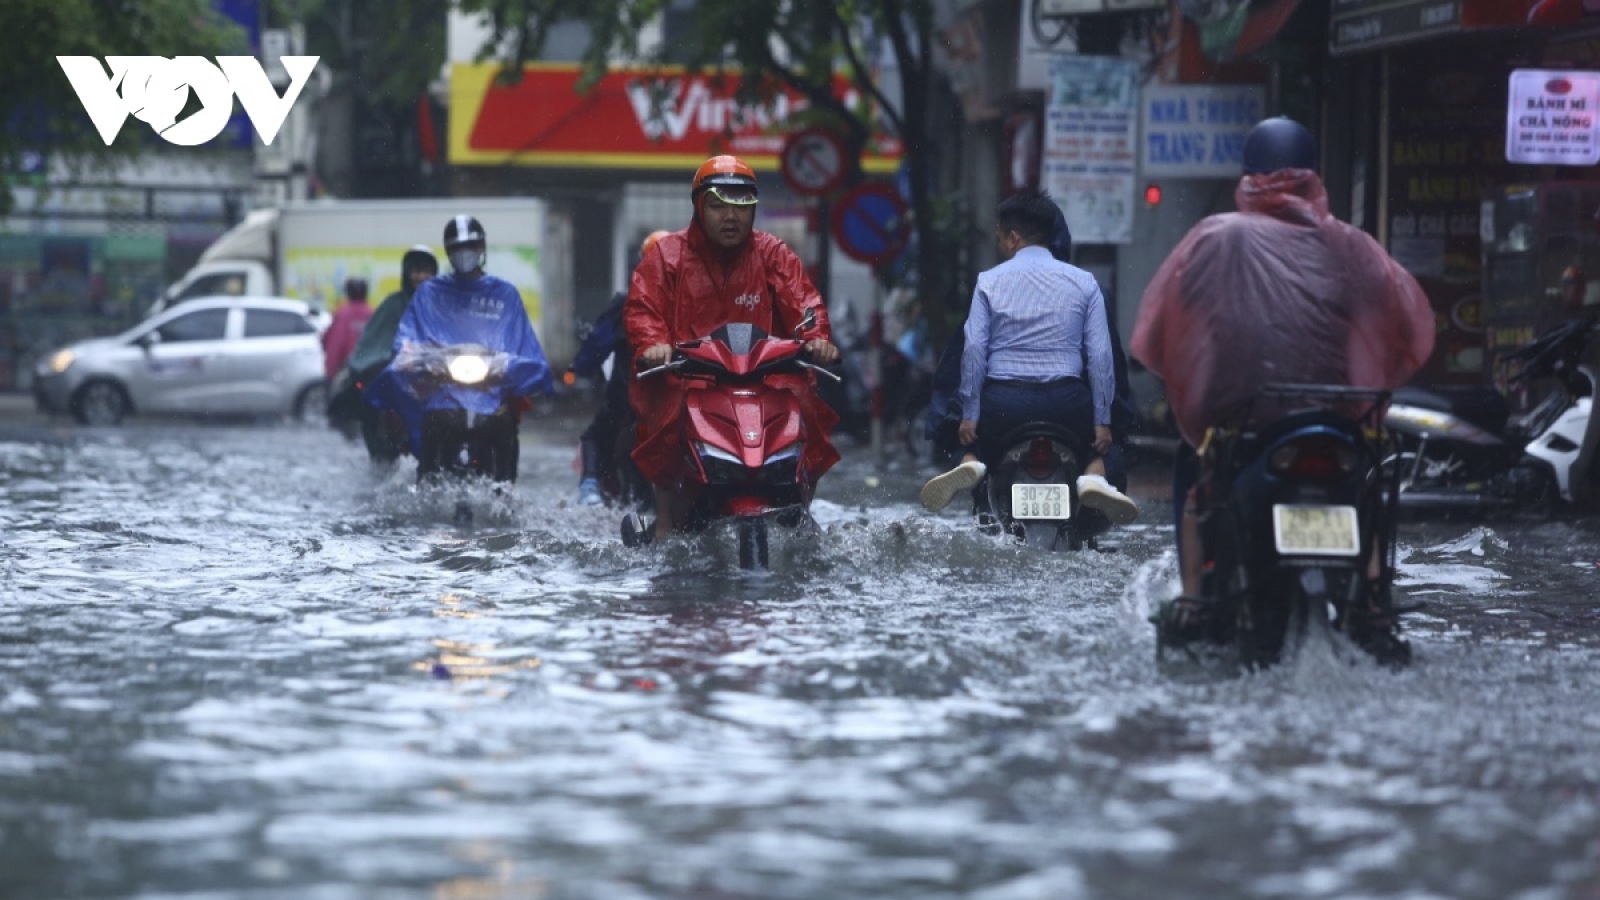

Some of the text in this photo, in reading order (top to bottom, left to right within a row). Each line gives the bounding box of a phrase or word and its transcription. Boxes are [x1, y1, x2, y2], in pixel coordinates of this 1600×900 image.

[1527, 97, 1586, 110] BÁNH MÌ
[1148, 132, 1206, 164] TRANG
[1021, 502, 1061, 517] 3888
